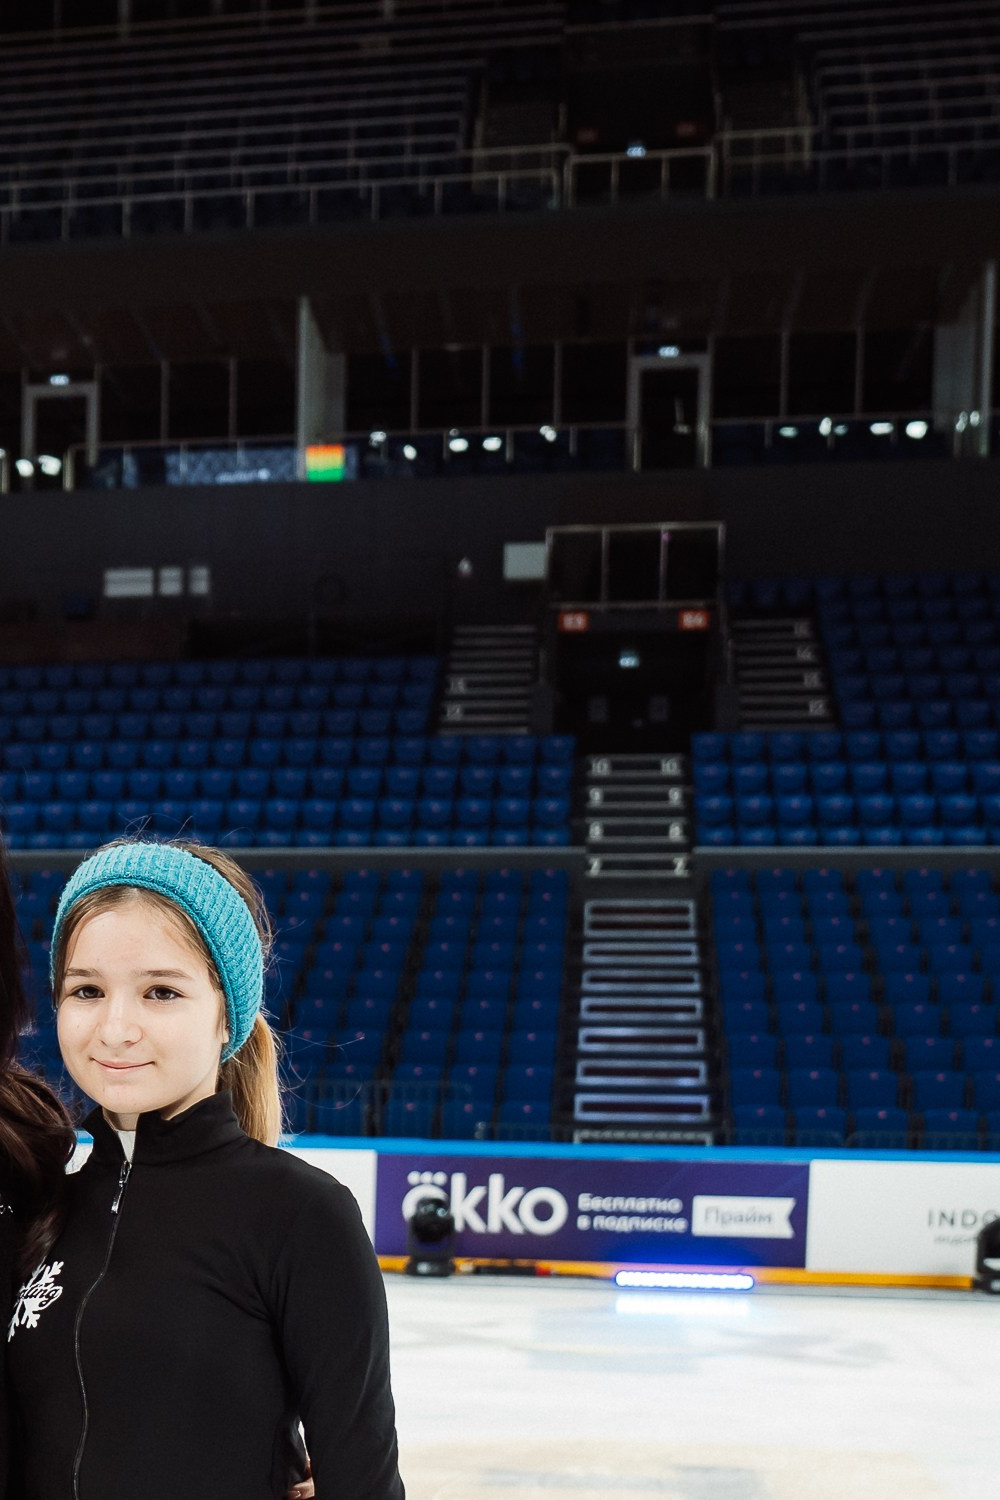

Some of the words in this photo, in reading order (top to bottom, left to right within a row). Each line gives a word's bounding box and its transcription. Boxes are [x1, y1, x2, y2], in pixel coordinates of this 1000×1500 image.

[578, 1193, 684, 1214] Бесплатно
[577, 1214, 591, 1231] в
[593, 1215, 688, 1233] подписке
[704, 1205, 774, 1226] Прайм
